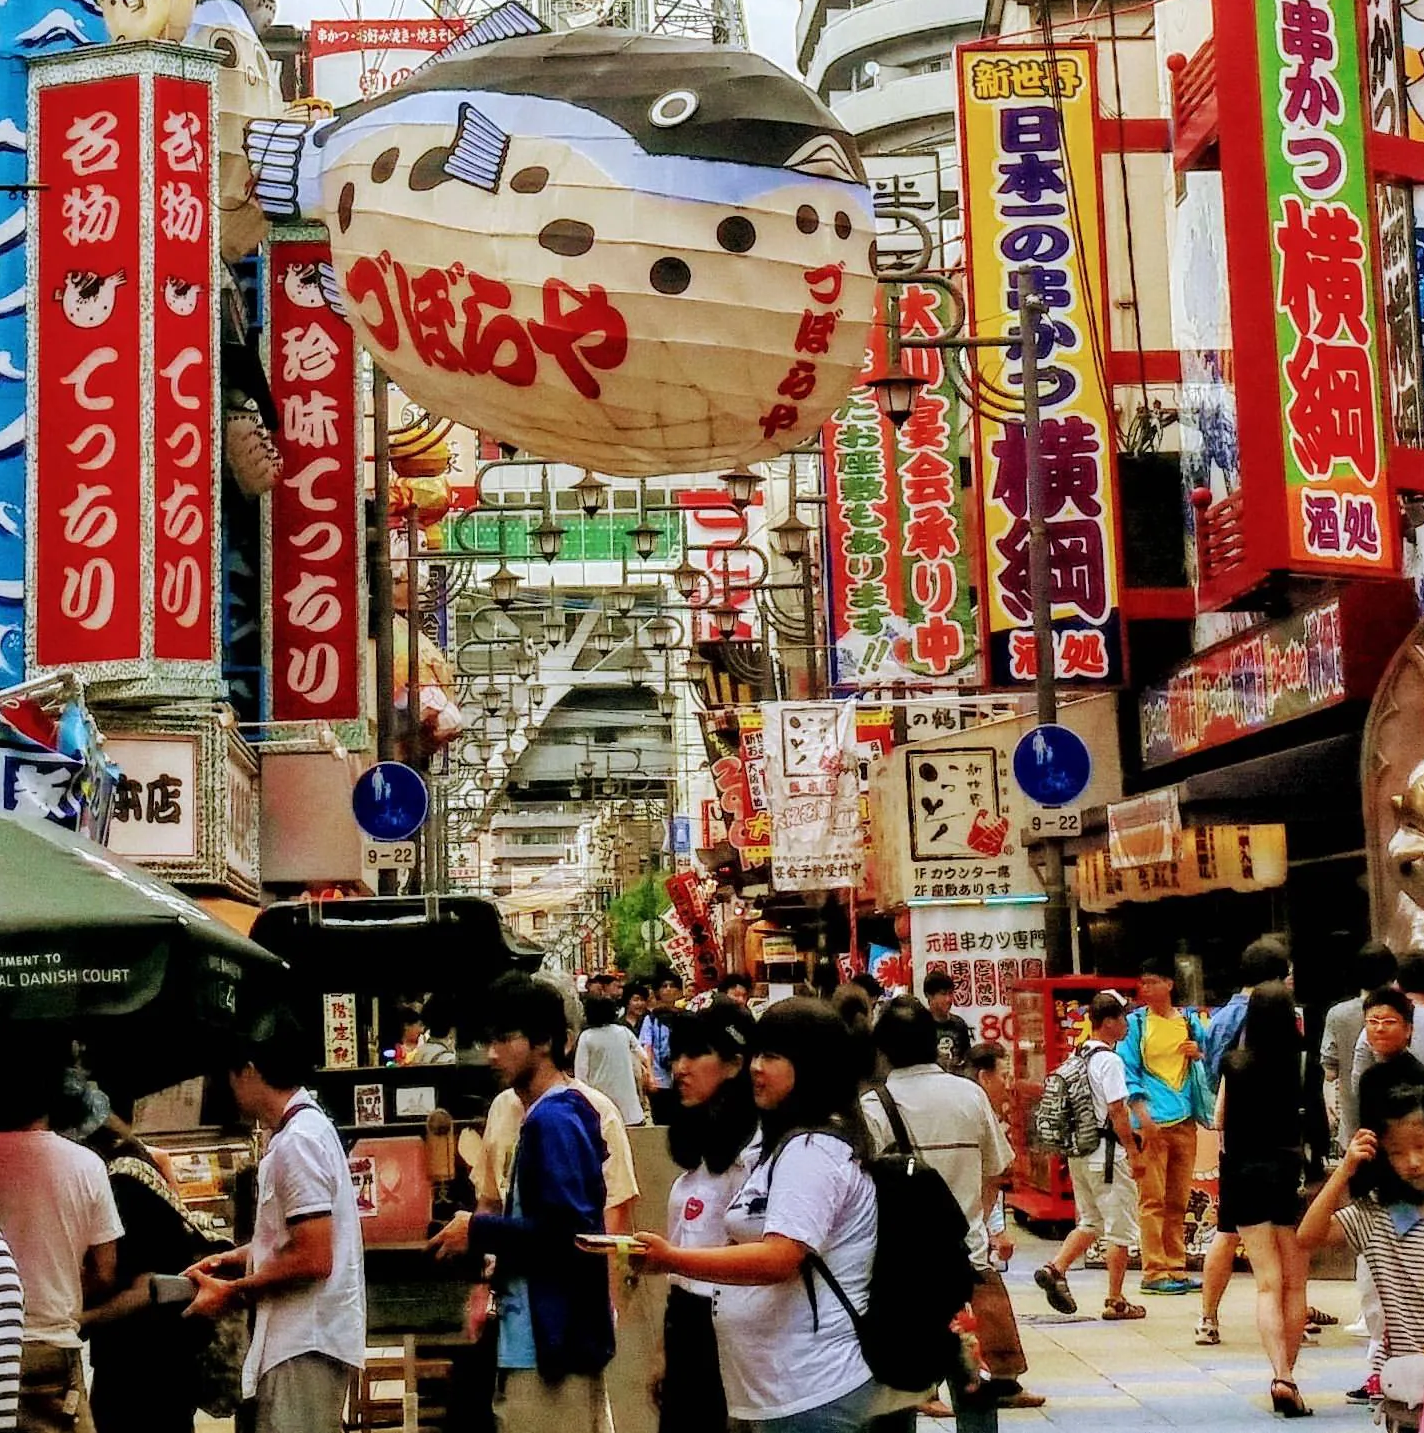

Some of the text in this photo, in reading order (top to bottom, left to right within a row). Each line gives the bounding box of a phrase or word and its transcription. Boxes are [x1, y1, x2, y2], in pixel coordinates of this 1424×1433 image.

[973, 60, 1081, 100] 新世界
[58, 111, 123, 632] 名物 てっちり
[160, 110, 204, 630] 名物 てっちり
[345, 251, 628, 400] づぼらや
[759, 263, 845, 440] づぼらや
[993, 110, 1107, 620] 日本一の串かつ 横綱
[1279, 203, 1375, 480] 横綱
[280, 321, 343, 706] 珍味てっちり
[1305, 493, 1378, 556] 酒処
[1011, 634, 1105, 674] 酒処
[368, 848, 413, 864] 9-22
[1032, 815, 1080, 831] 9-22
[19, 970, 76, 986] DANISH
[82, 968, 130, 983] COURT
[45, 952, 61, 964] TO
